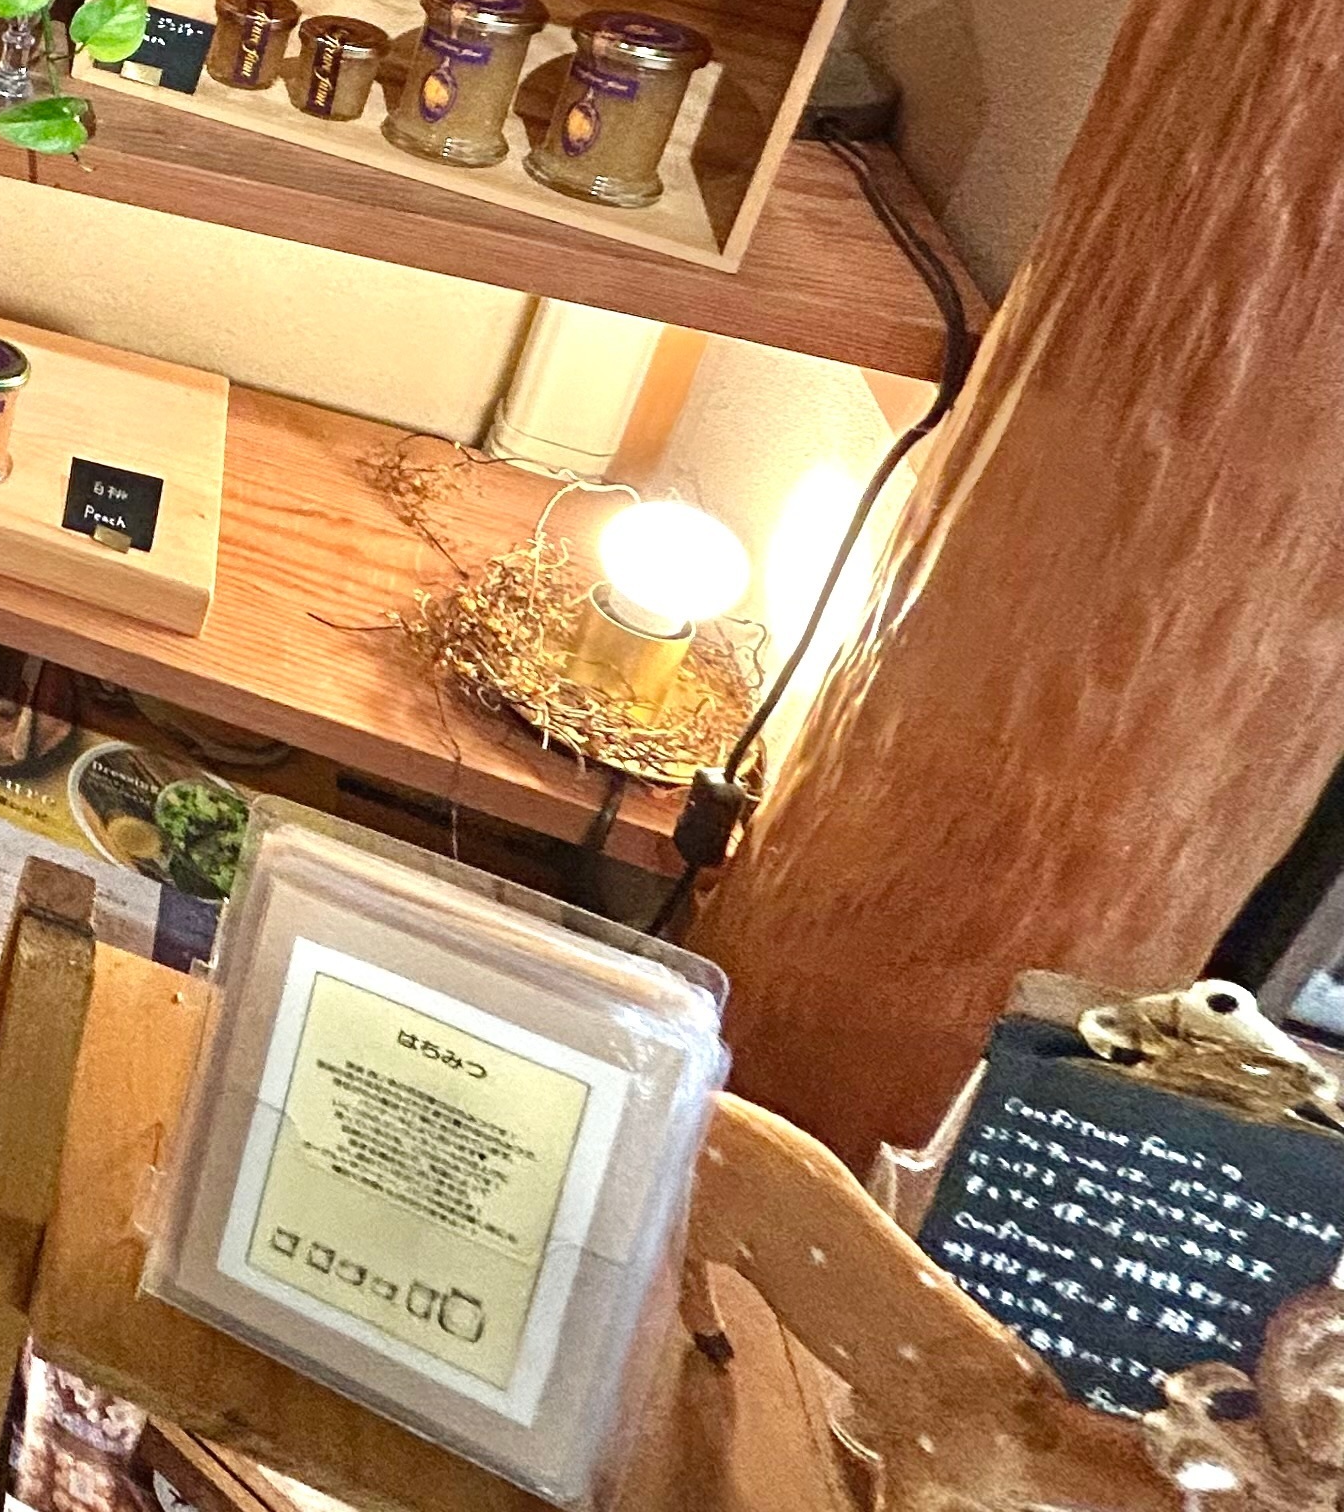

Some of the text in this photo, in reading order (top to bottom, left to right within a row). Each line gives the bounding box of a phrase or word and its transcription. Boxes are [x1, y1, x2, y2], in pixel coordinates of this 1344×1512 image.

[83, 504, 127, 529] Peach
[397, 1028, 489, 1080] はちみつ
